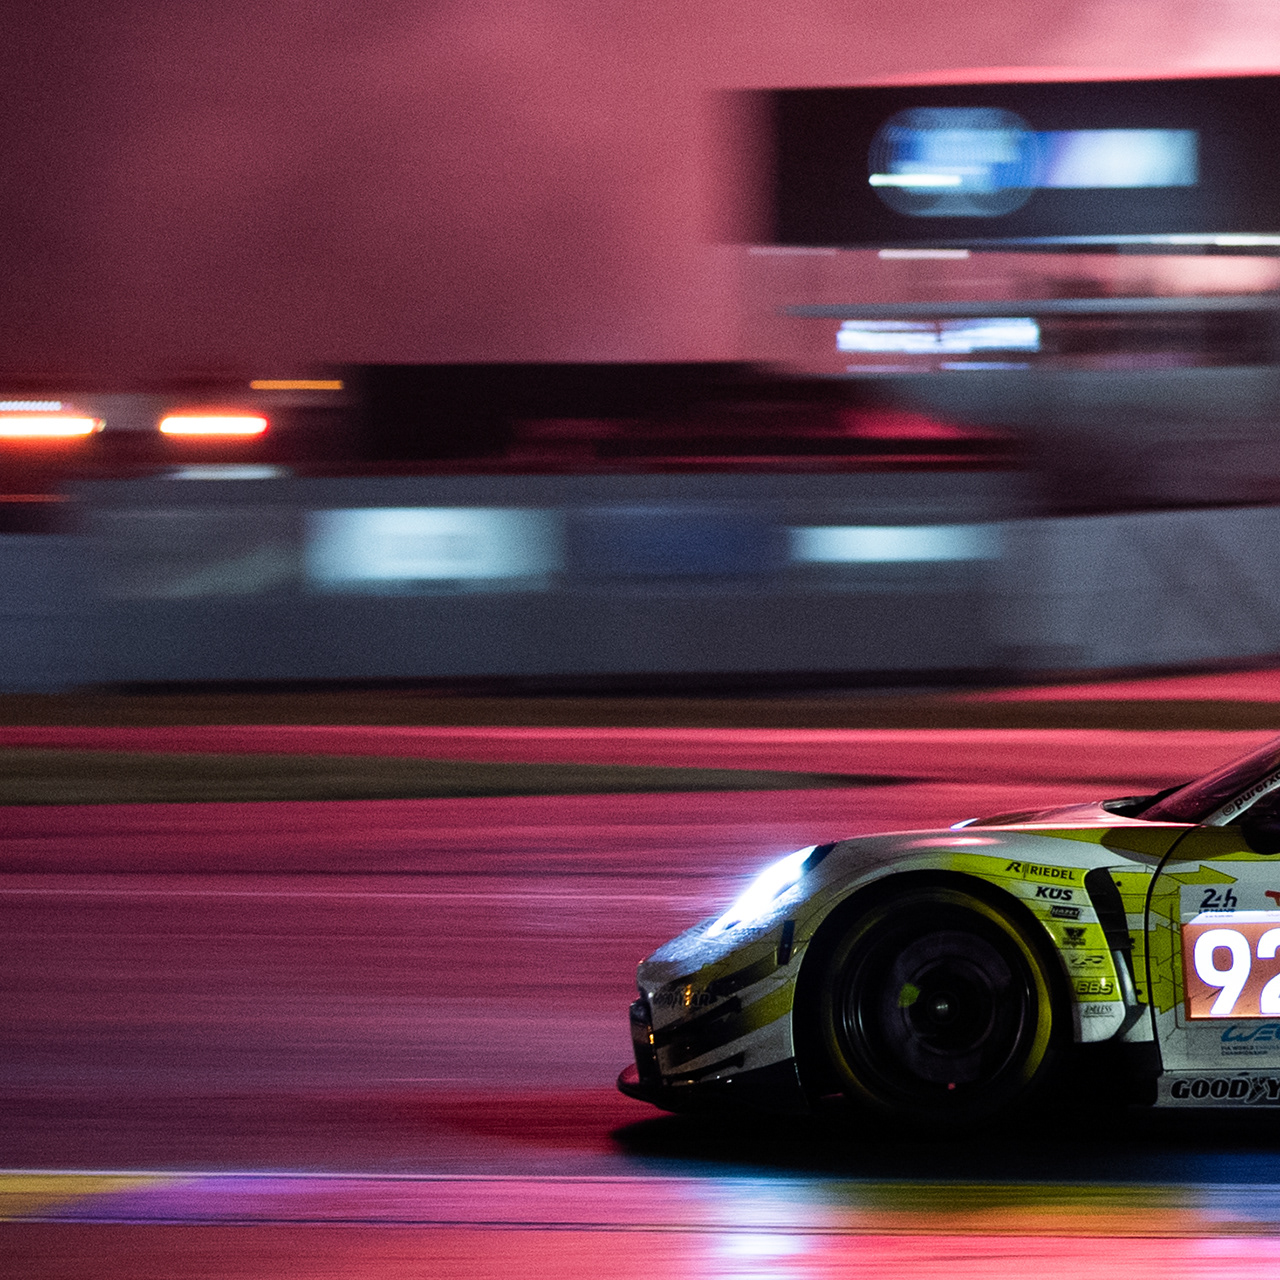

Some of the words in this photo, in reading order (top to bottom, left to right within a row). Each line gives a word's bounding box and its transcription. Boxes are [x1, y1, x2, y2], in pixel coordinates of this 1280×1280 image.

[1029, 865, 1075, 881] RIEDEL
[1035, 886, 1073, 901] KÜS
[1200, 888, 1238, 908] 24h
[1077, 980, 1114, 996] BBS
